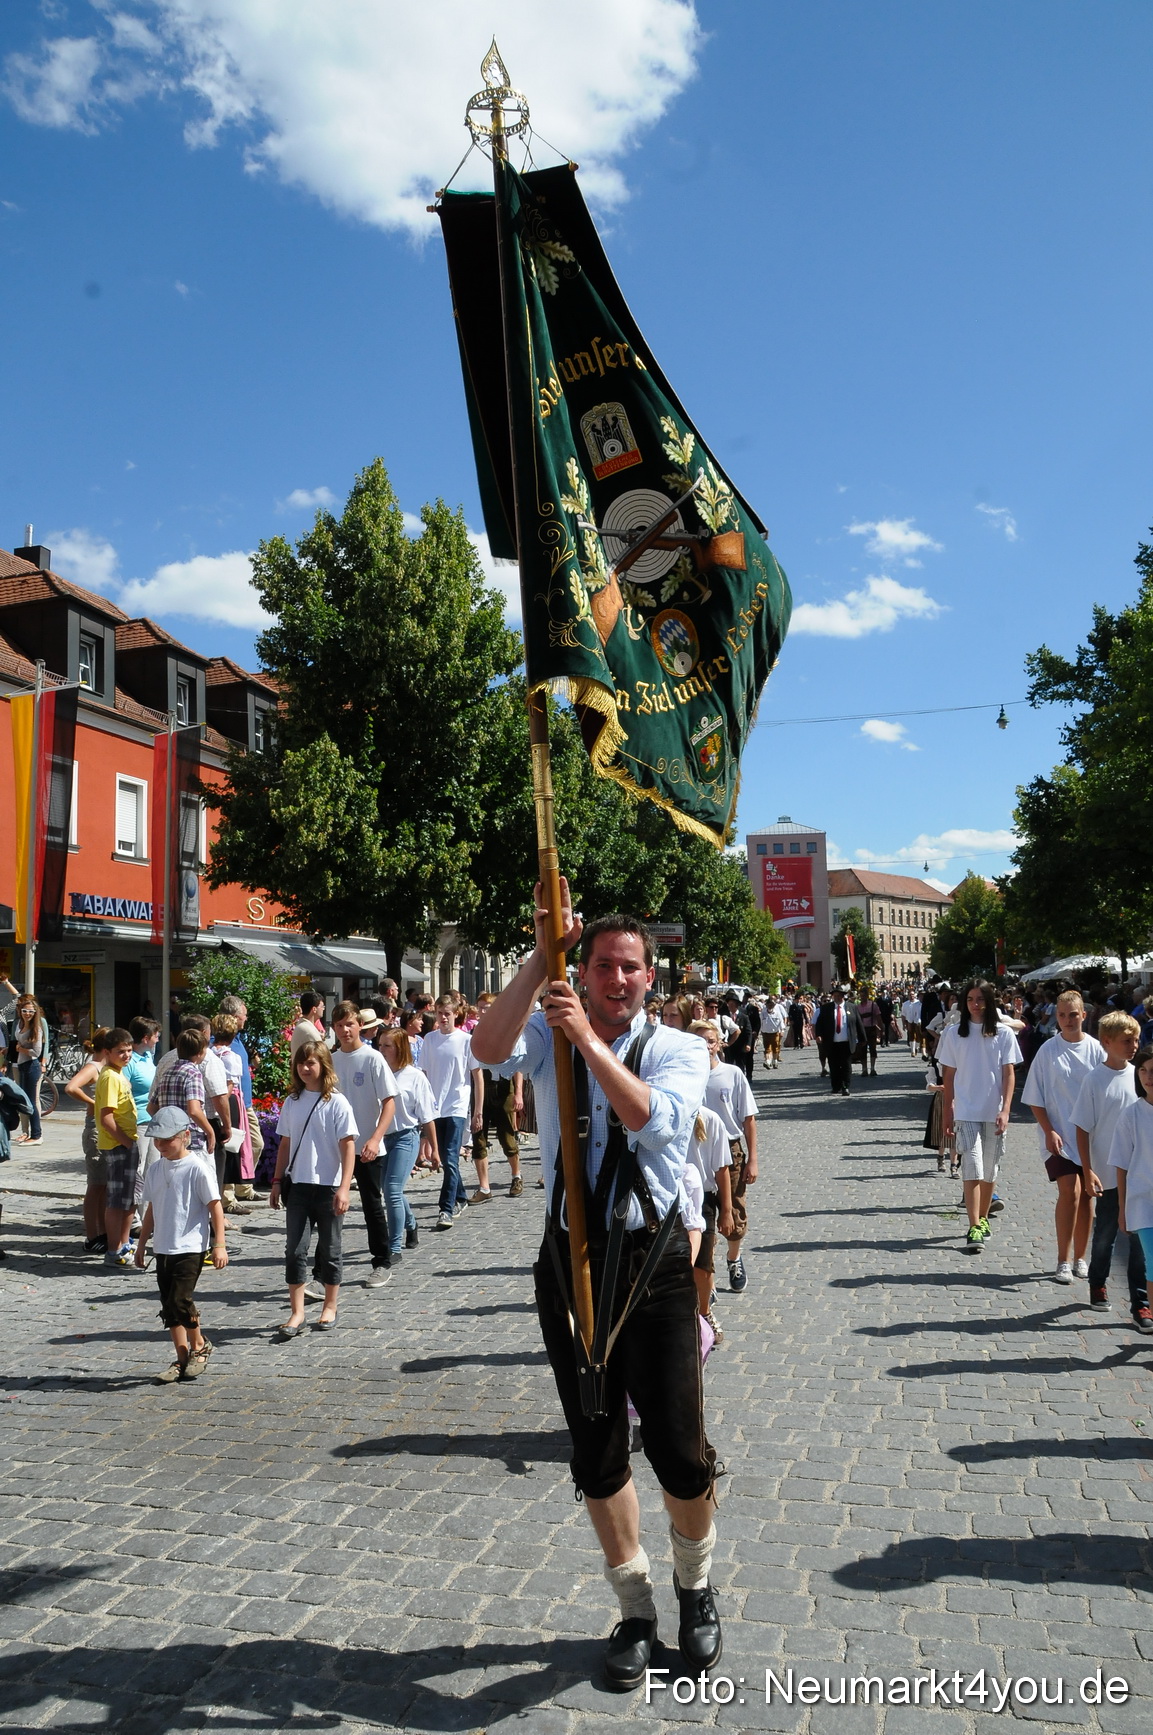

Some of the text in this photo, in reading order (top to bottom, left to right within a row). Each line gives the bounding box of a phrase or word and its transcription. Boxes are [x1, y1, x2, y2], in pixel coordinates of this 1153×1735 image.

[635, 681, 675, 715] Ziel
[725, 582, 769, 659] Leben
[781, 898, 799, 907] 175
